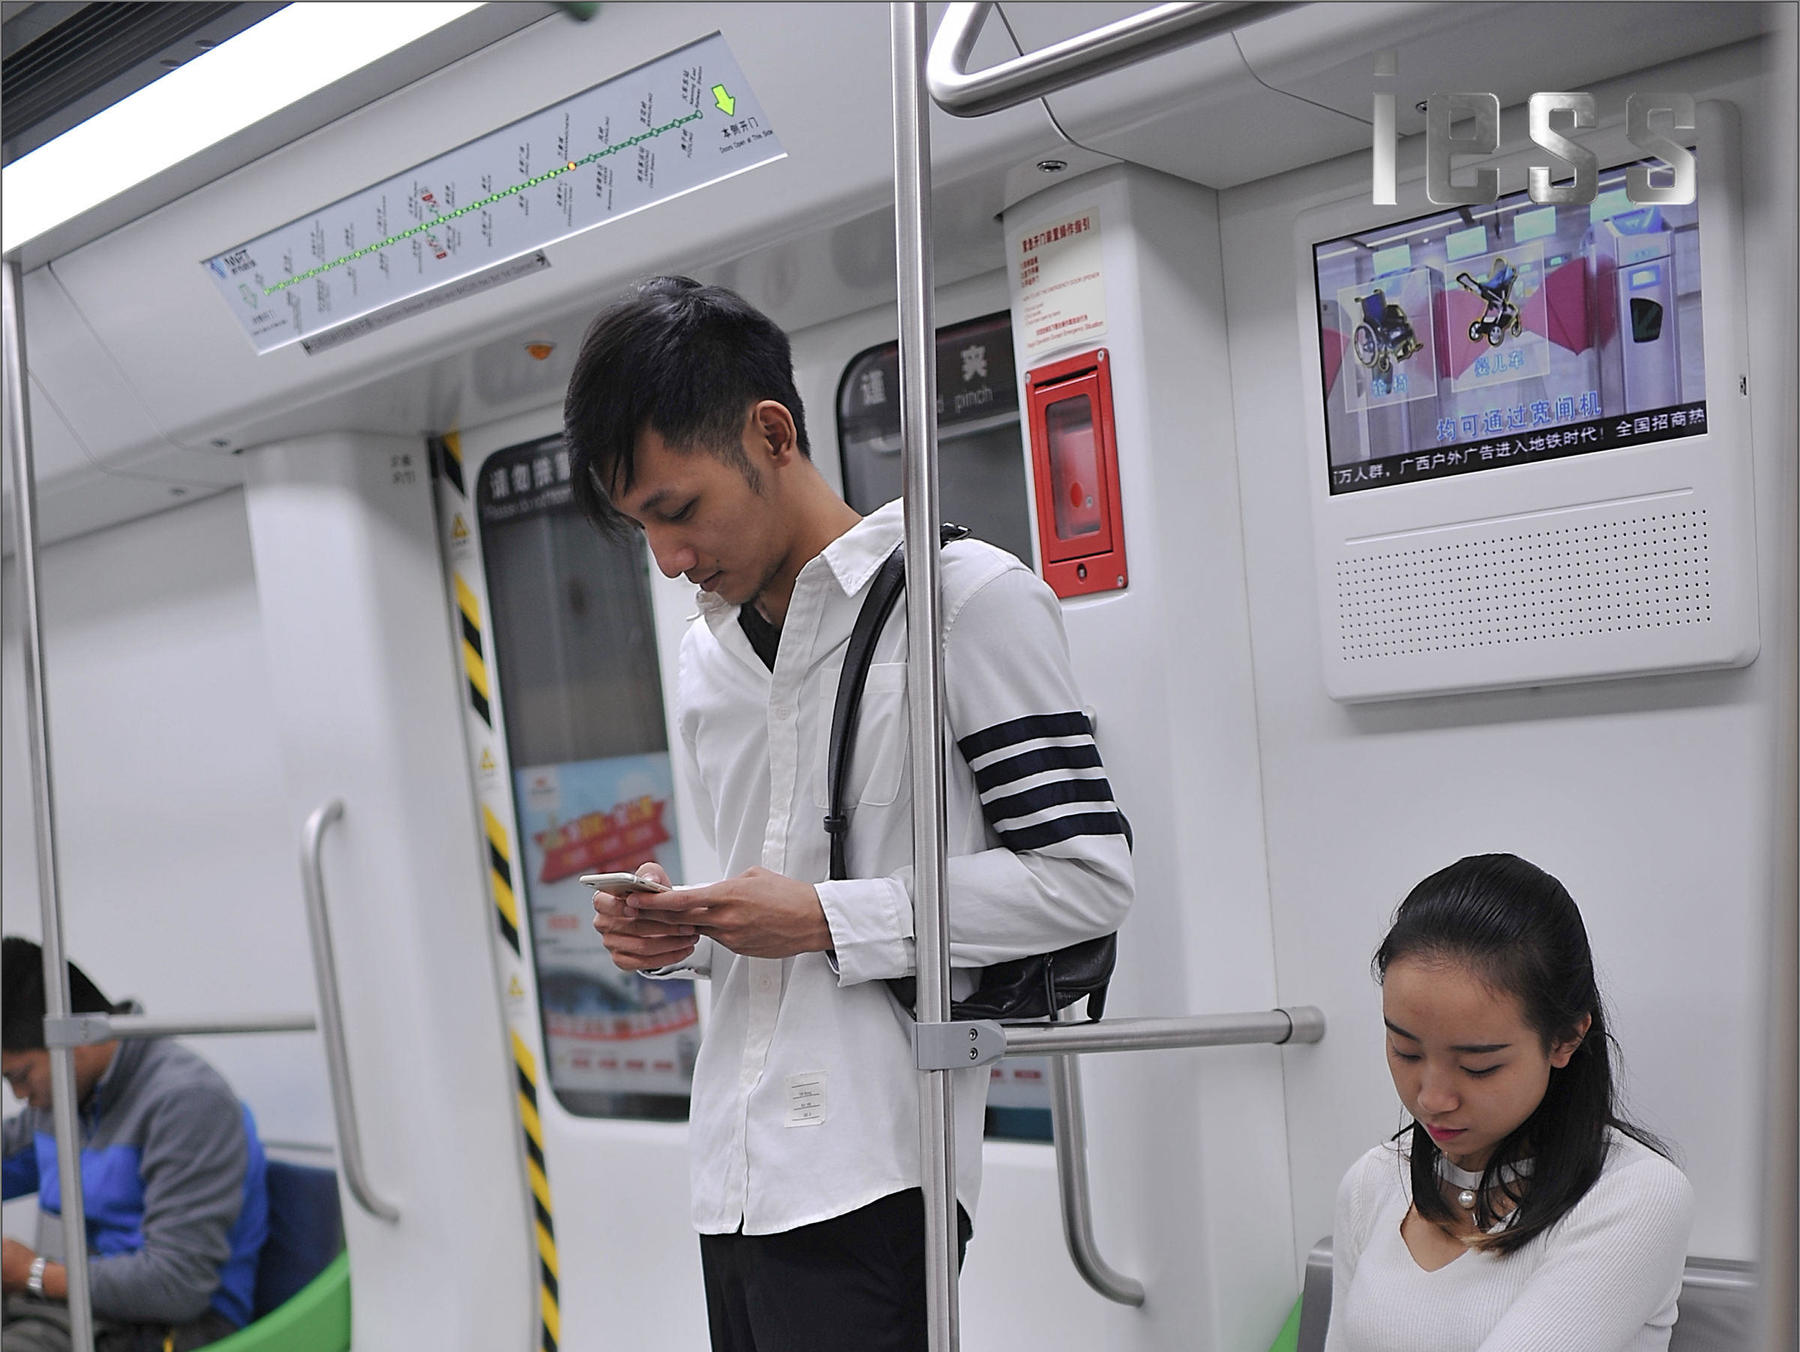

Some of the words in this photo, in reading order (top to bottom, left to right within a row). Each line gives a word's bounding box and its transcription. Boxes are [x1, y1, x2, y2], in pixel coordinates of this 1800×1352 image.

[1436, 391, 1602, 442] 均可通过宽闸机
